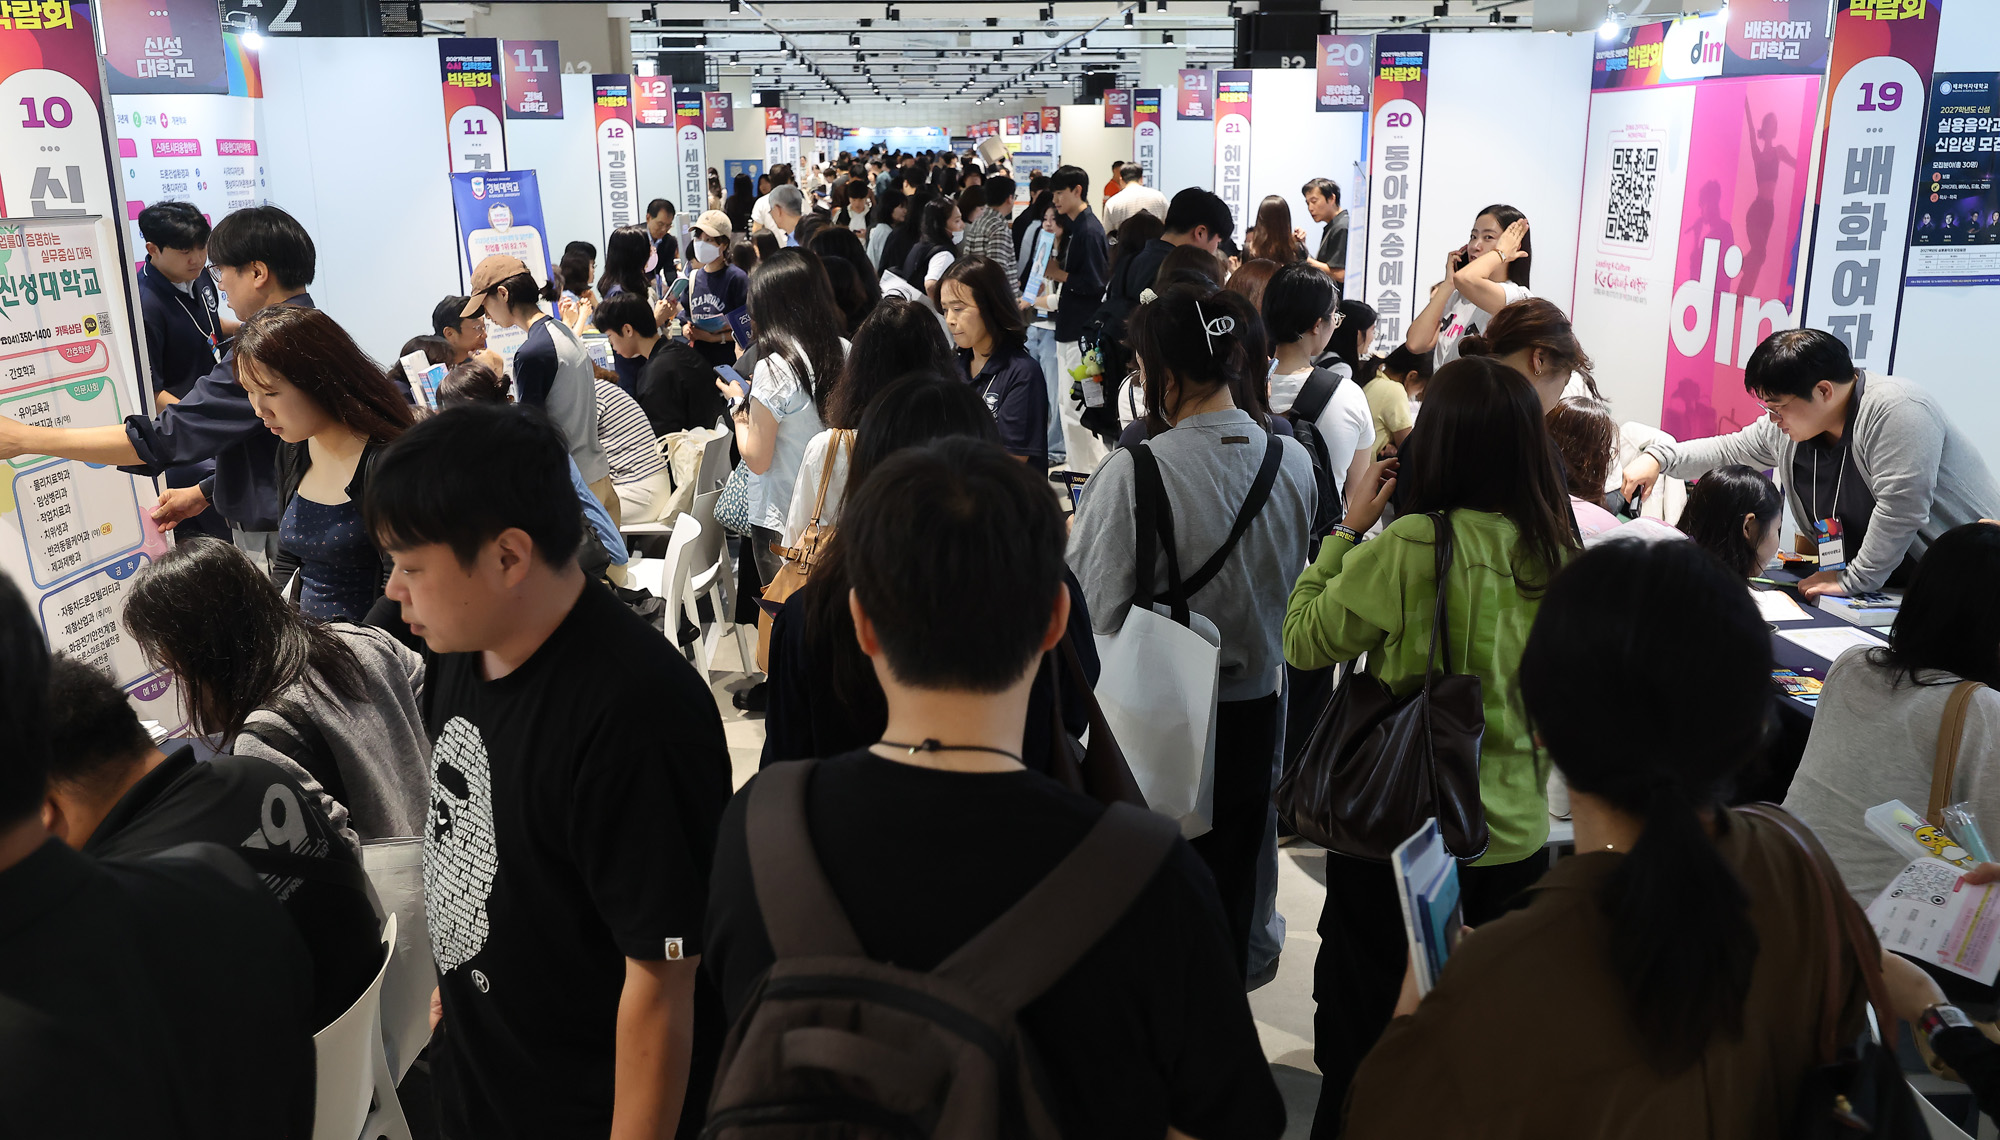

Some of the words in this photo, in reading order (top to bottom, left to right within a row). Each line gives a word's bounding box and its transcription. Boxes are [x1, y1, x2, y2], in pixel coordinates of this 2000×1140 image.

[1744, 20, 1811, 40] 배화여자
[144, 36, 183, 57] 신성
[1326, 43, 1364, 67] 20
[1750, 42, 1801, 61] 대학교
[136, 58, 196, 79] 대학교
[513, 49, 549, 73] 11
[447, 72, 492, 88] 박람회
[1184, 75, 1208, 91] 21
[1380, 67, 1421, 82] 박람회
[640, 82, 667, 98] 12
[1857, 82, 1904, 112] 19
[519, 102, 549, 113] 대학교
[709, 96, 729, 109] 13
[1108, 93, 1128, 105] 22
[19, 96, 73, 129] 10
[768, 111, 782, 119] 14
[1940, 106, 1976, 114] 2027학년도
[1978, 106, 1991, 114] 신설
[463, 119, 488, 135] 11
[1225, 123, 1241, 133] 21
[1386, 113, 1412, 127] 20
[607, 127, 624, 139] 12
[684, 132, 698, 140] 13
[1141, 128, 1154, 136] 22
[1935, 137, 1977, 153] 신입생
[30, 166, 87, 217] 신
[26, 232, 62, 248] 증명하는
[41, 247, 76, 263] 실무중심
[76, 246, 93, 260] 대학
[0, 268, 102, 307] 신성대학교
[55, 323, 82, 337] 카톡상담
[65, 345, 92, 358] 간호학부
[8, 364, 36, 381] 간호학과
[73, 382, 100, 397] 인문사회
[18, 401, 50, 420] 유아교육과
[33, 468, 71, 492] 물리치료학과
[36, 487, 68, 508] 임상병리과
[40, 503, 72, 523] 작업치료과
[43, 521, 69, 540] 치위생과
[46, 530, 91, 558] 반려동물케어과
[50, 551, 82, 573] 제과제빵과
[60, 581, 121, 618] 자동차드론모빌리티과
[64, 613, 96, 637] 제철산업과
[68, 620, 117, 654] 화공전기안전계열
[456, 818, 477, 834] GINZA
